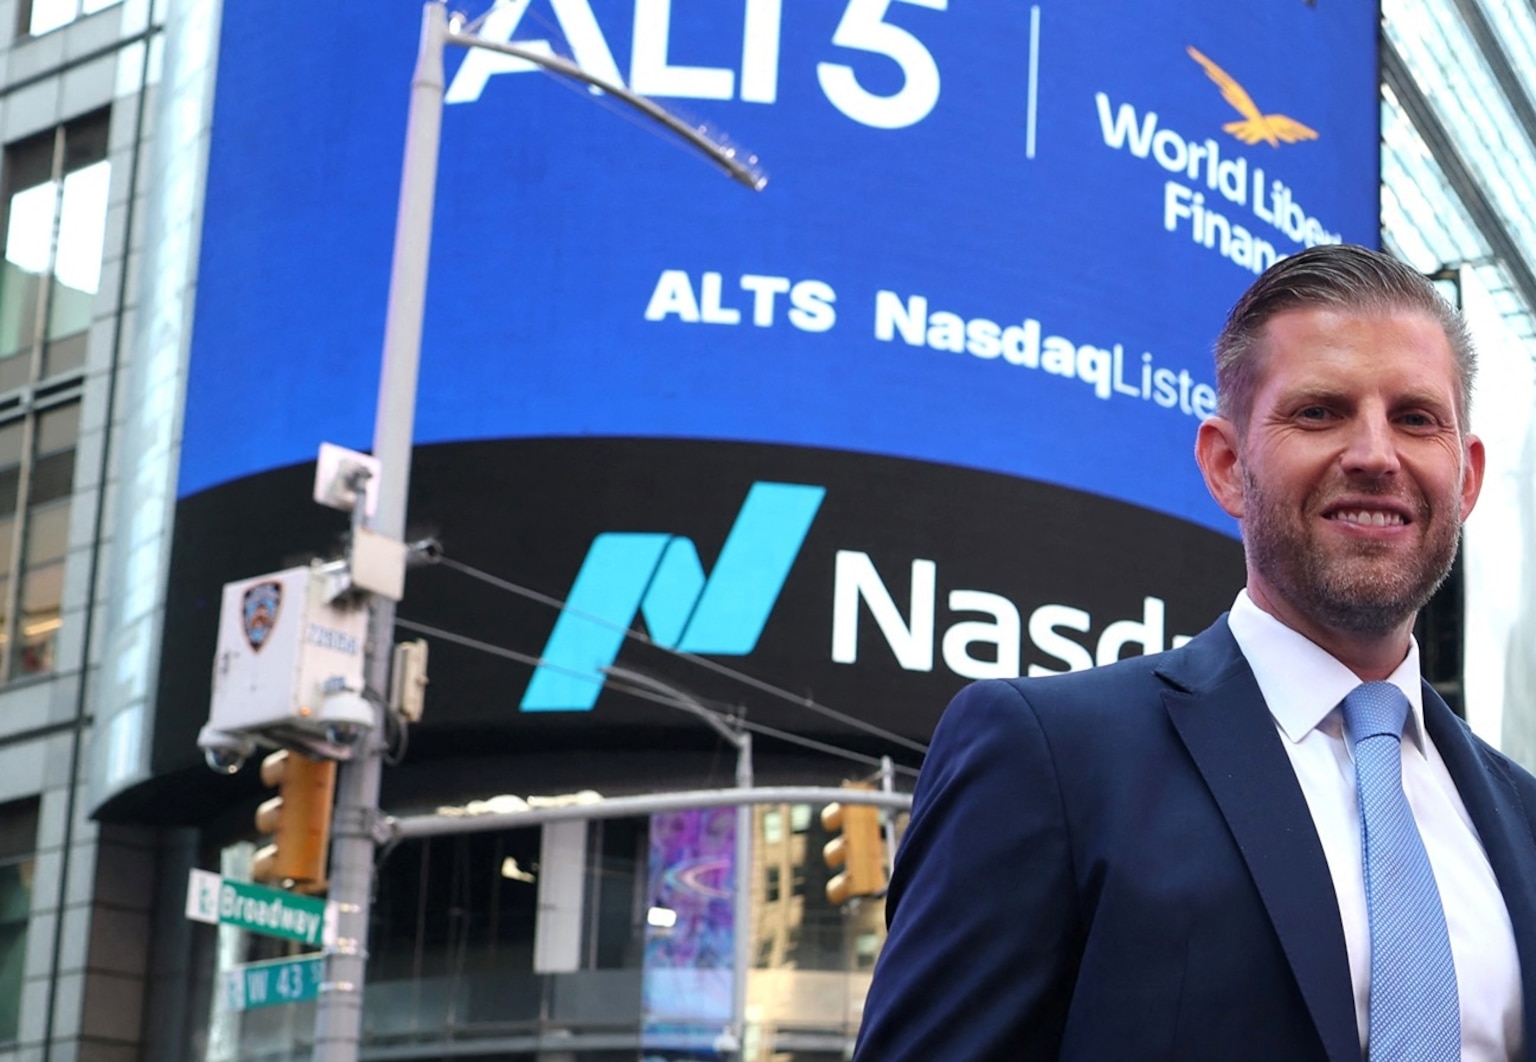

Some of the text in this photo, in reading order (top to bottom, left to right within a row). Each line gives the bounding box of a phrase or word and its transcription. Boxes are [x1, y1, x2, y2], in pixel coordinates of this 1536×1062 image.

[1095, 91, 1247, 206] World
[1164, 181, 1288, 275] Finan
[645, 270, 836, 331] ALTS
[832, 550, 1192, 680] Nasd
[220, 884, 321, 943] Broadway
[247, 970, 269, 1003] W
[276, 964, 304, 999] 43
